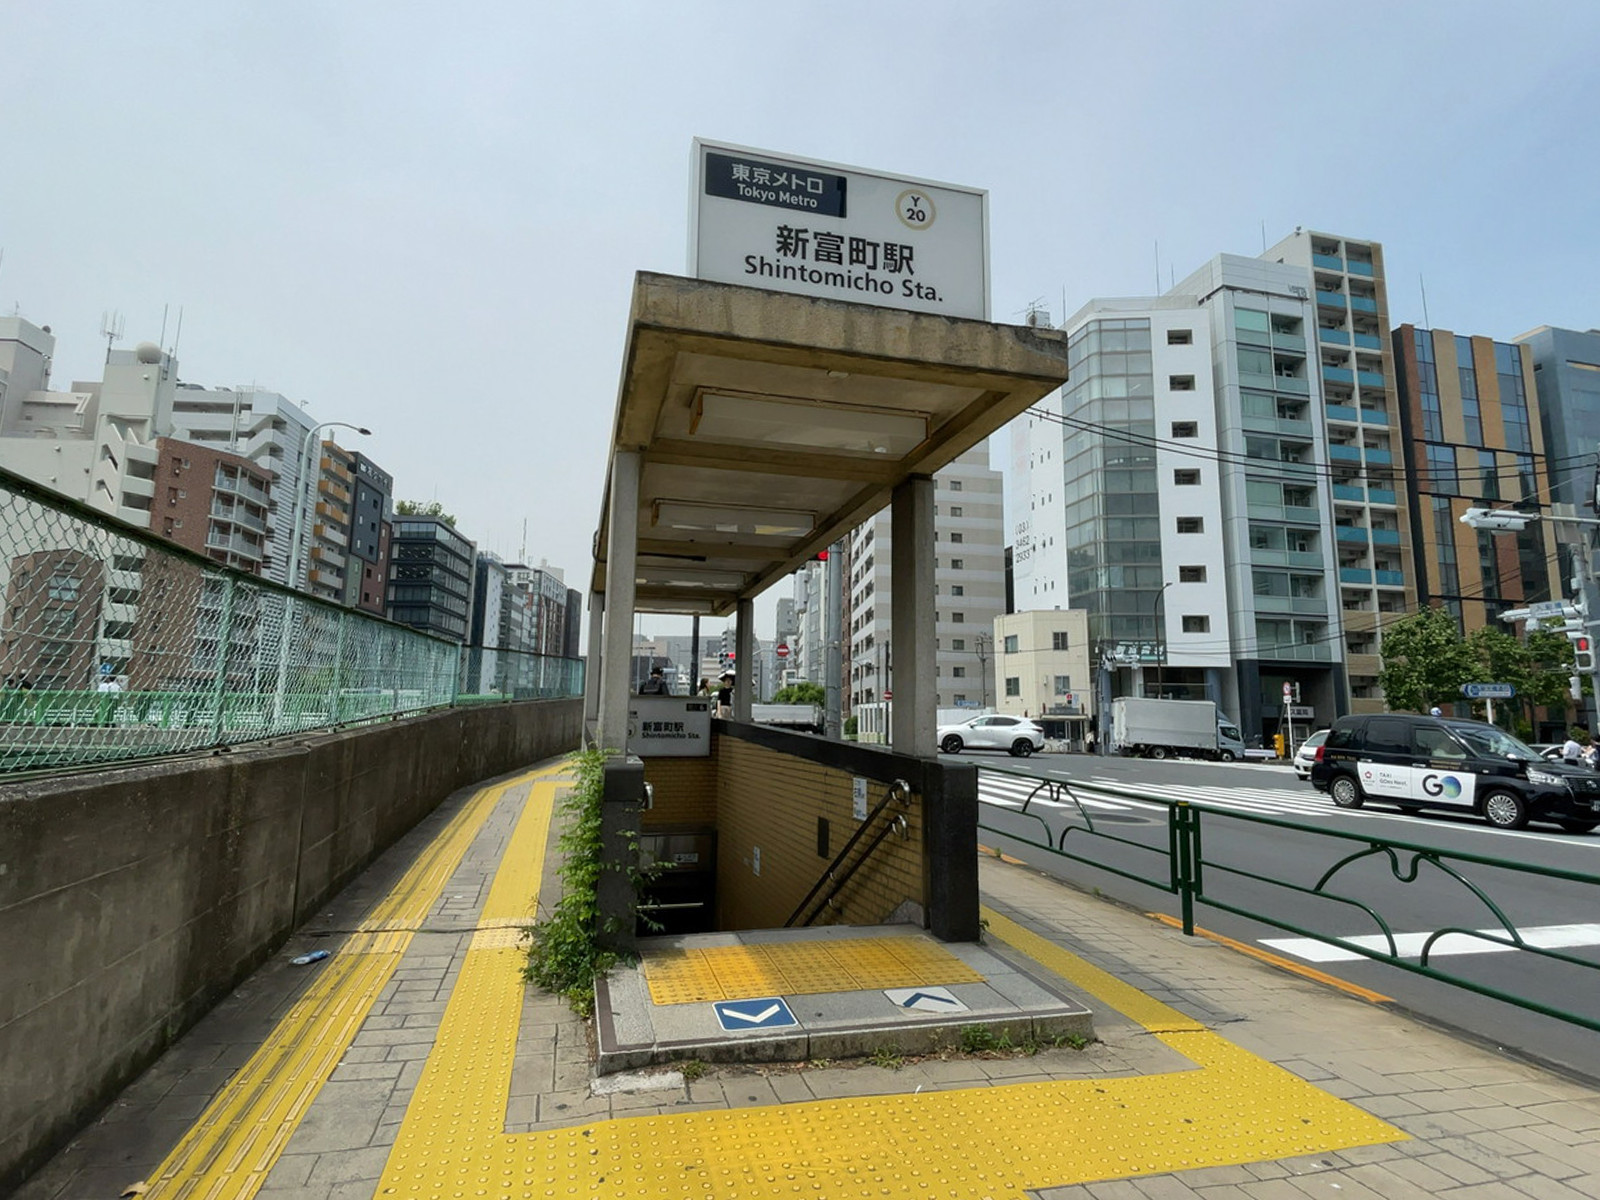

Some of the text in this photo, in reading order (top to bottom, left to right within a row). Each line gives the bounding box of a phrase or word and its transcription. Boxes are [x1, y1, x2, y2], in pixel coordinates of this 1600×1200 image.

[731, 163, 823, 194] 東京メトロ
[737, 183, 818, 208] Tokyo Metro
[911, 196, 921, 207] Y
[906, 208, 925, 222] 20
[776, 224, 915, 276] 新富町駅
[744, 255, 943, 302] Shintomicho Sta.
[642, 721, 684, 732] 新富町駅
[1422, 774, 1462, 798] GO
